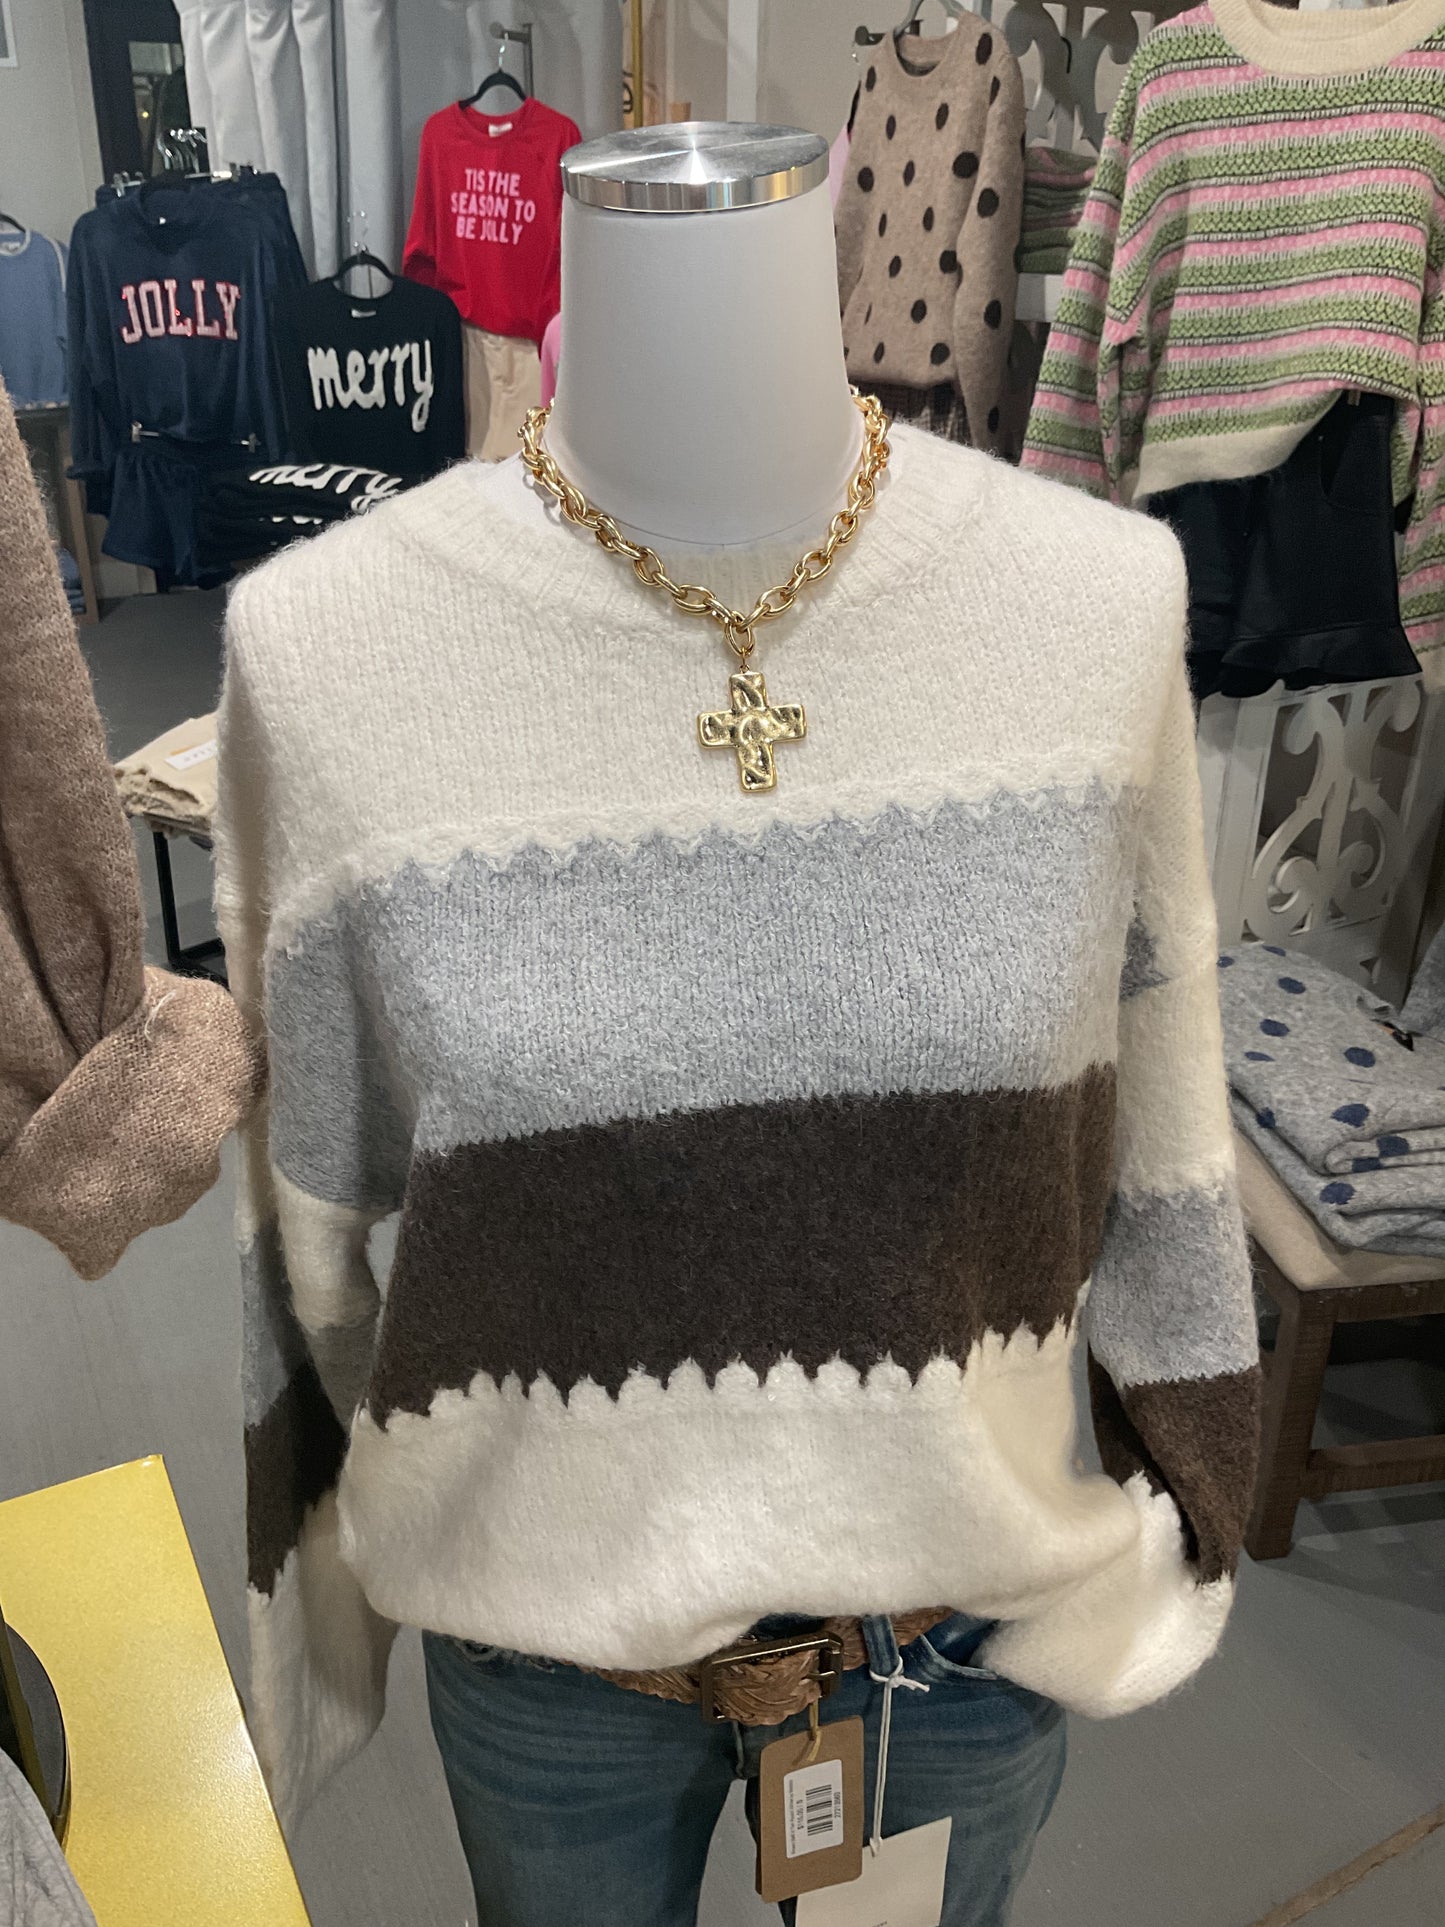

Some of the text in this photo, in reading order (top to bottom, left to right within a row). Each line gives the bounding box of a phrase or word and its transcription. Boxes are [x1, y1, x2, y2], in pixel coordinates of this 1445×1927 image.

[465, 168, 521, 197] TIS THE
[451, 191, 536, 223] SEASON TO
[456, 215, 523, 245] BE JOLLY
[121, 278, 241, 344] JOLLY
[307, 339, 434, 432] merry
[249, 463, 403, 515] merry
